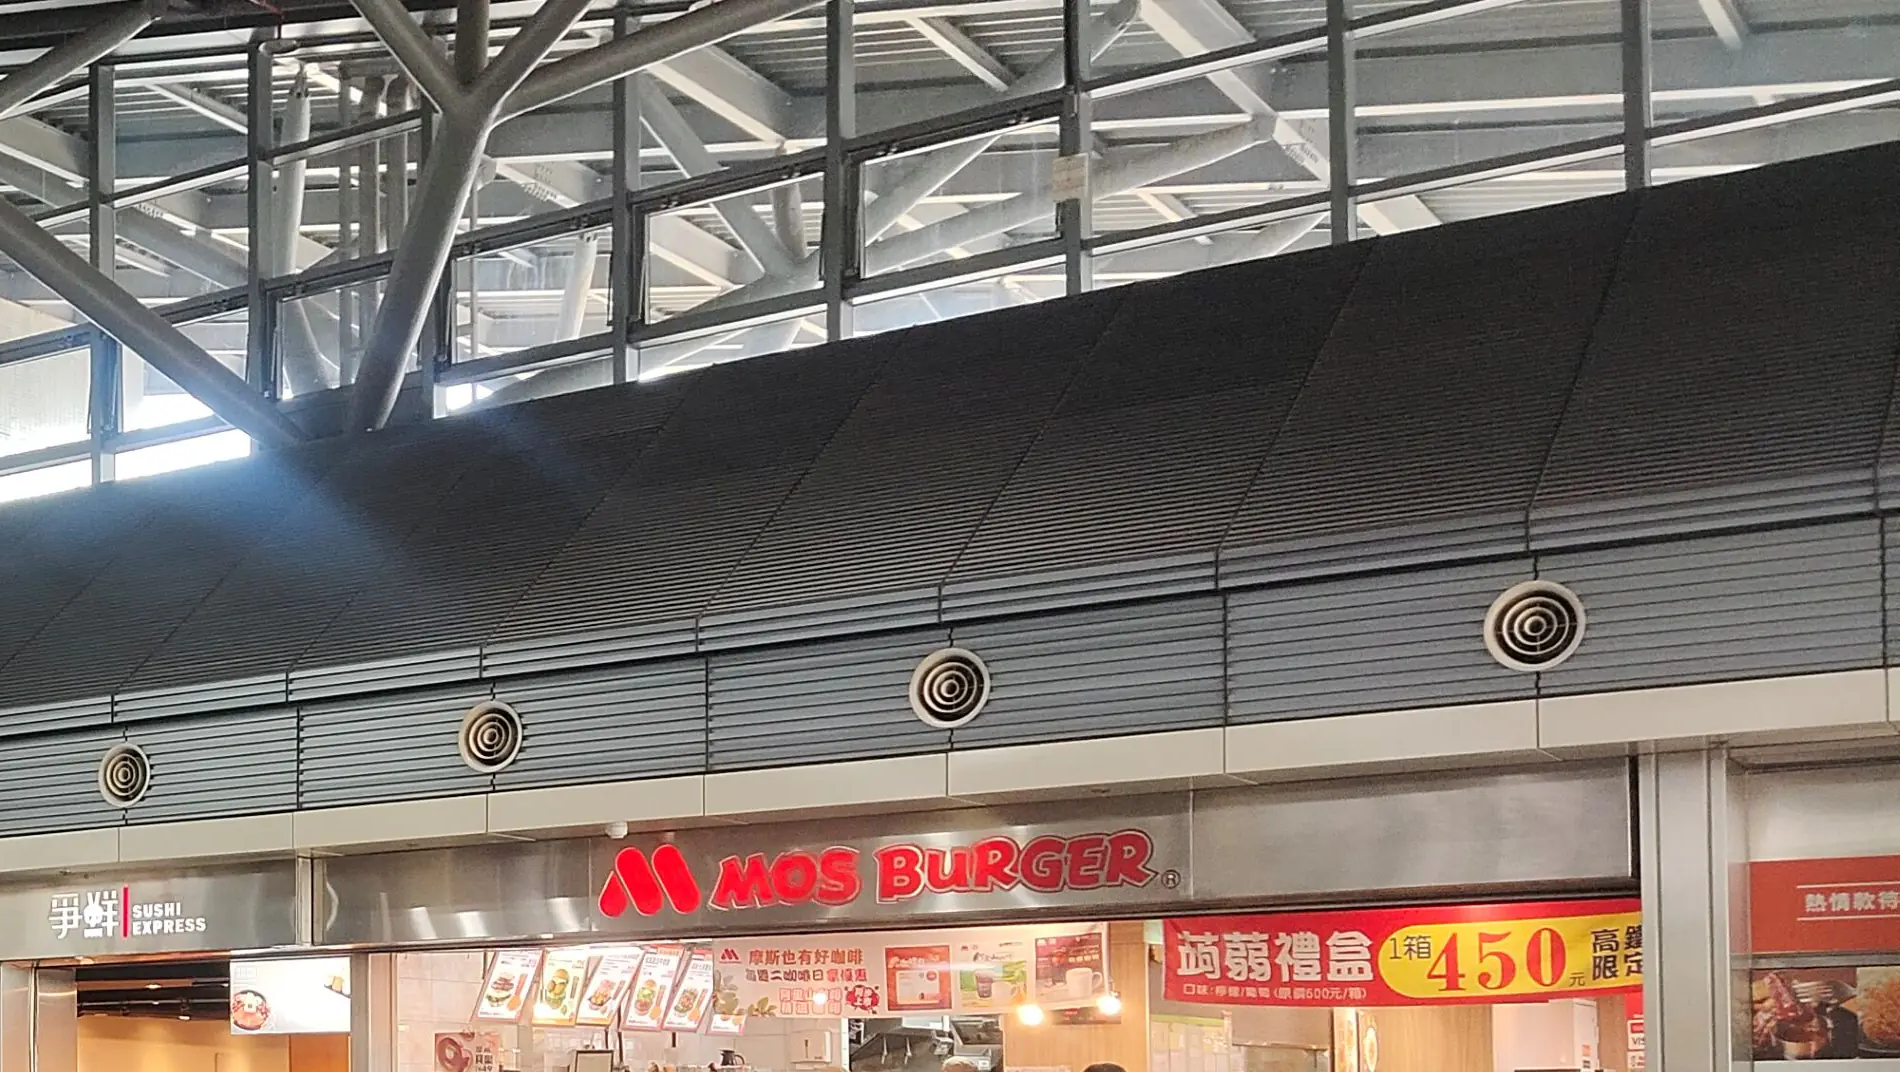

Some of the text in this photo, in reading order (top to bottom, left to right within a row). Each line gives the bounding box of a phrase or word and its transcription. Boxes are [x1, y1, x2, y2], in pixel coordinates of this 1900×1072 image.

[707, 830, 1156, 913] MOS BURGER
[48, 890, 120, 939] 爭鮮
[132, 902, 181, 919] SUSHI
[132, 917, 207, 936] EXPRESS
[749, 948, 863, 966] 摩斯也有好咖啡
[1177, 930, 1375, 982] 蒟蒻禮盒
[1389, 927, 1586, 992] 1箱 450 元
[1591, 953, 1644, 981] 限定
